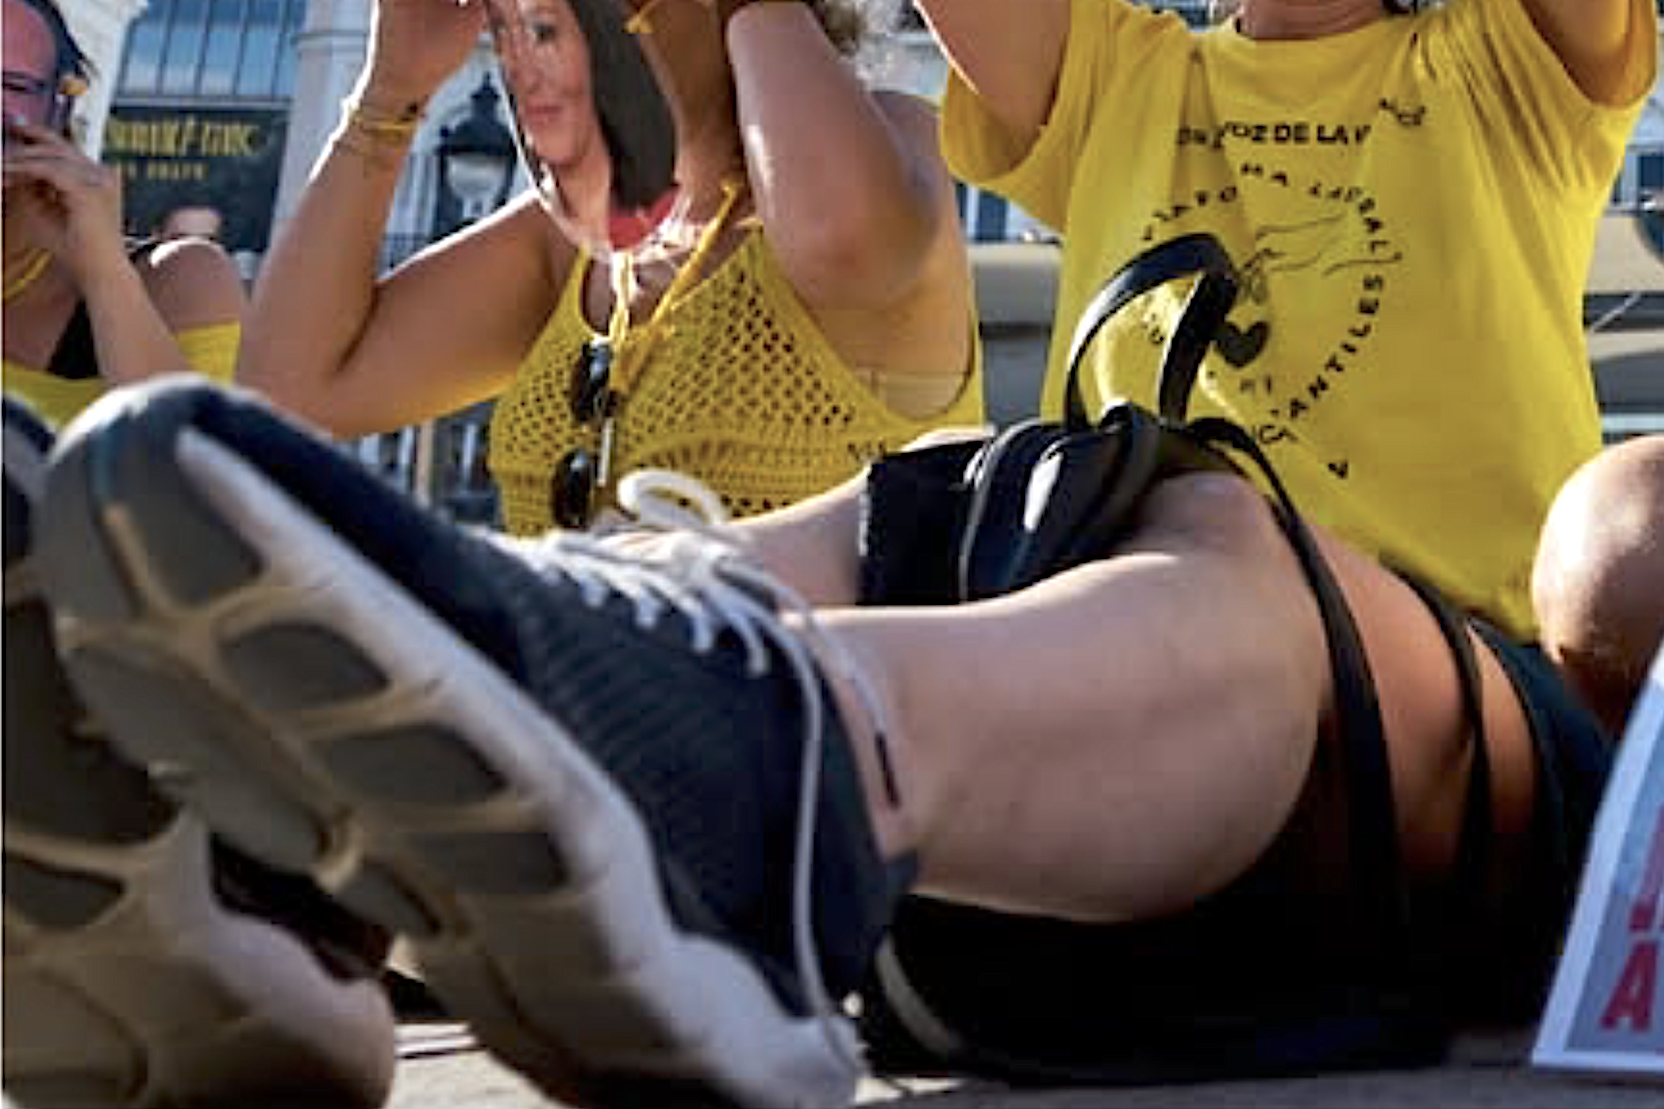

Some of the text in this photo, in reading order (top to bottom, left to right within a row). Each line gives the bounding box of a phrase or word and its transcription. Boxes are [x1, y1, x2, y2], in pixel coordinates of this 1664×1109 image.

[1274, 122, 1310, 145] DE
[1316, 124, 1349, 146] LA
[1601, 939, 1660, 1032] A
